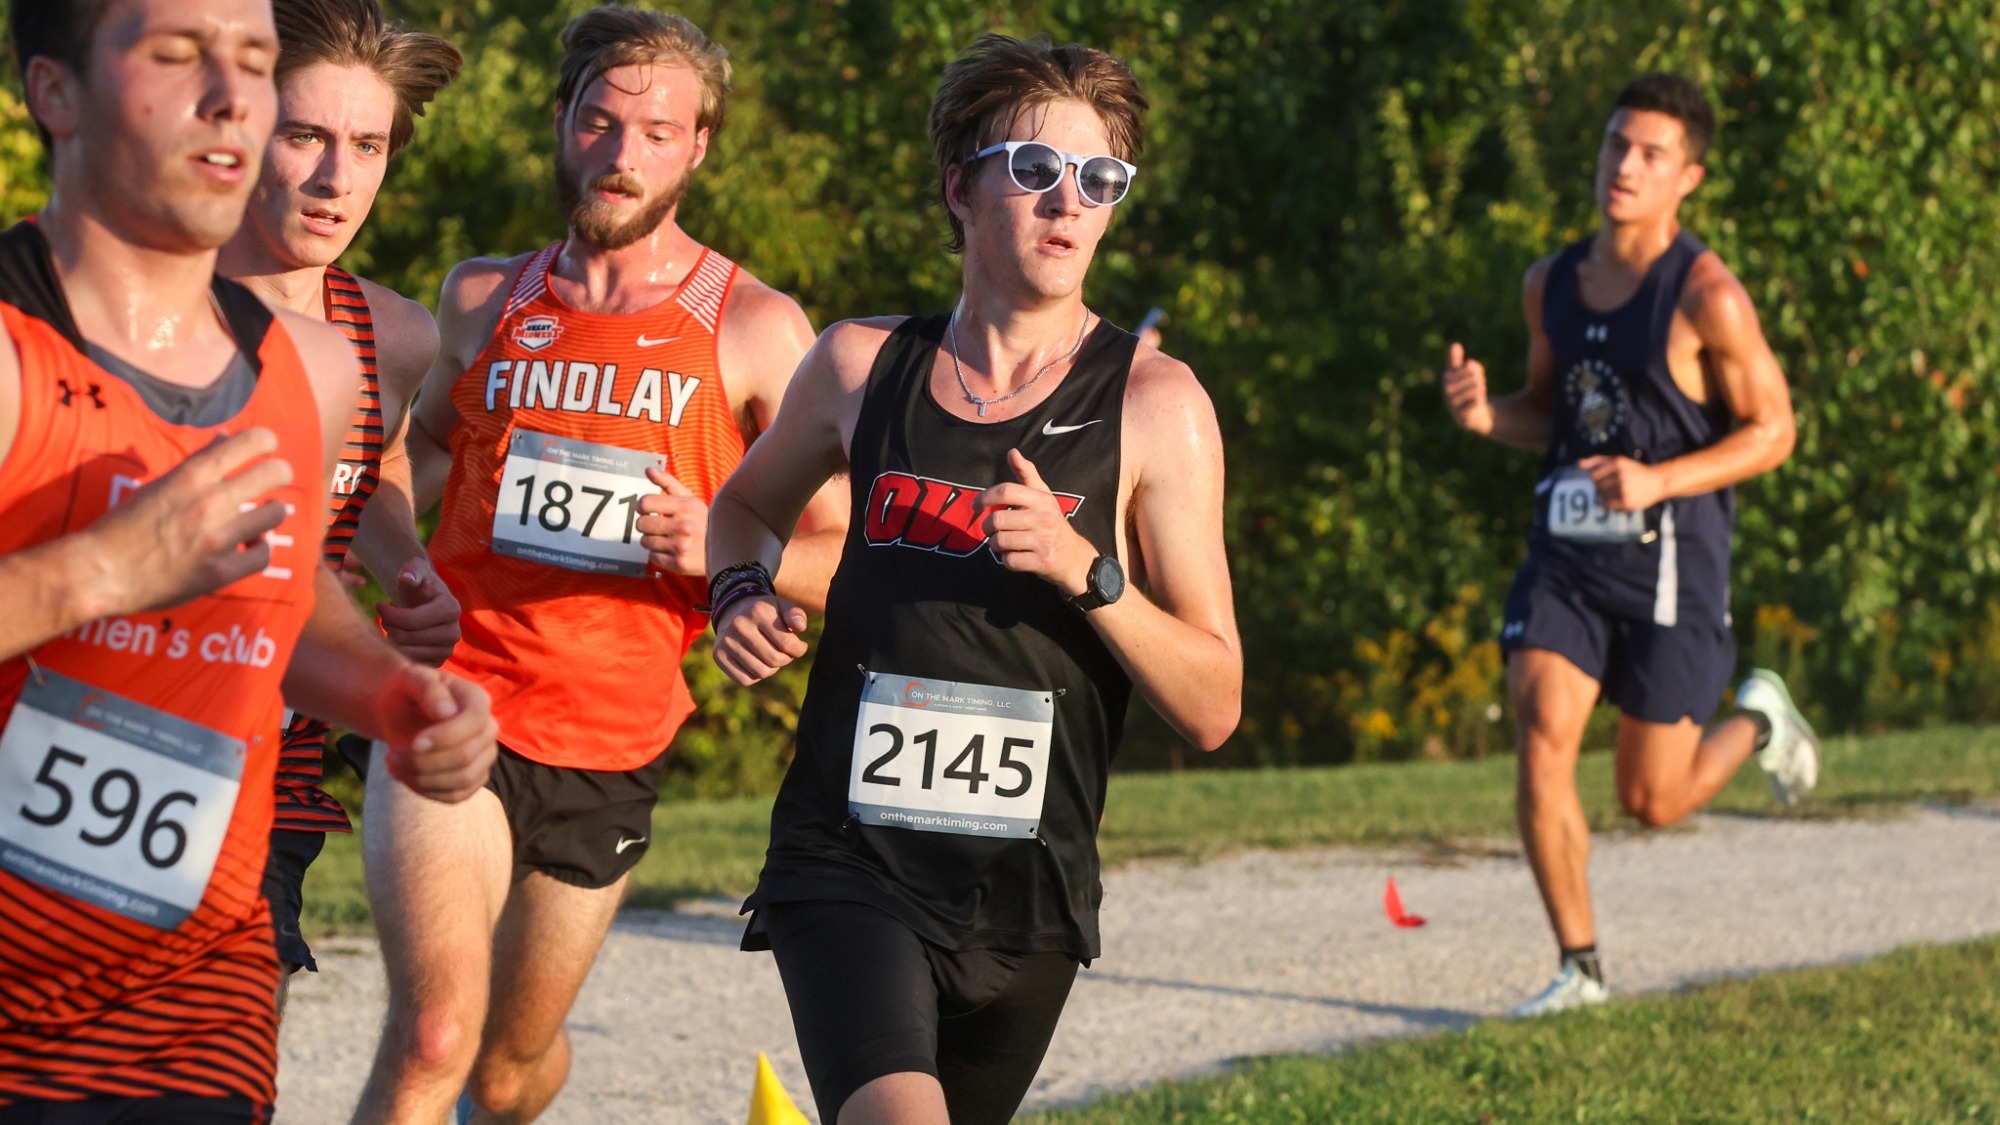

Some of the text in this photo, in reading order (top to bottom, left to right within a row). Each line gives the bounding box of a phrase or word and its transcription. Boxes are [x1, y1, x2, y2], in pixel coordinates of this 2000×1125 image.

[485, 359, 702, 428] FINDLAY
[514, 475, 638, 545] 1871
[516, 547, 619, 570] onthemarktiming.com
[200, 624, 276, 668] club
[911, 691, 924, 699] ON
[925, 692, 941, 701] THE
[942, 695, 965, 703] MARK
[966, 697, 995, 707] TIMING,
[996, 700, 1012, 709] LLC
[861, 723, 1035, 798] 2145
[19, 745, 198, 869] 596
[881, 811, 1008, 832] onthemarktiming.com
